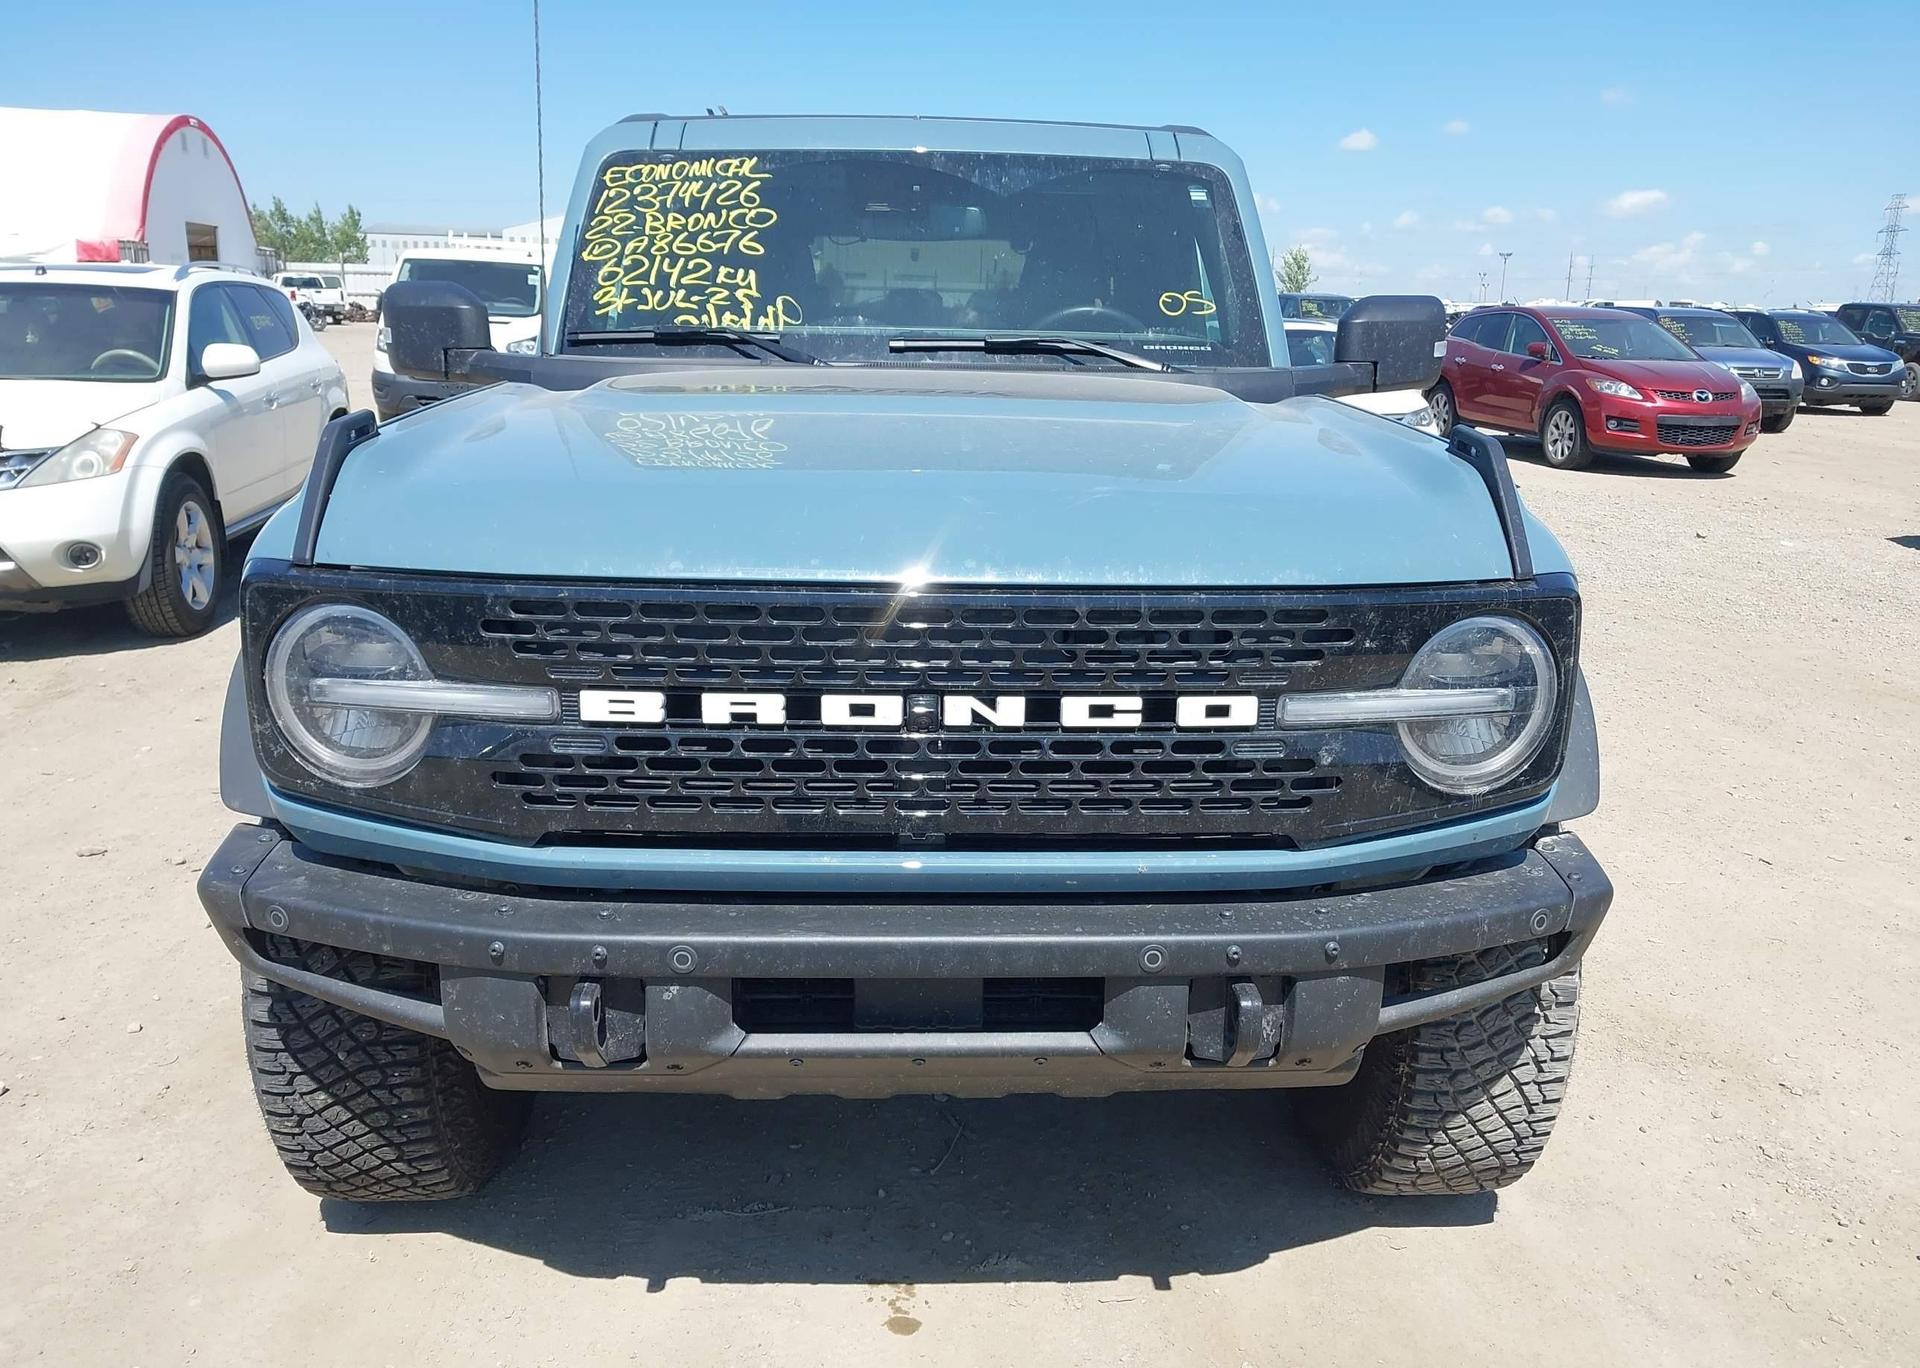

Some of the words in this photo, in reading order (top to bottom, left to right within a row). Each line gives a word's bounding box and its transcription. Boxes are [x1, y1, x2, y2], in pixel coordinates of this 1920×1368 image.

[603, 156, 773, 187] ECONOMICAL
[597, 254, 712, 288] 62142
[579, 689, 1260, 728] BRONCO
